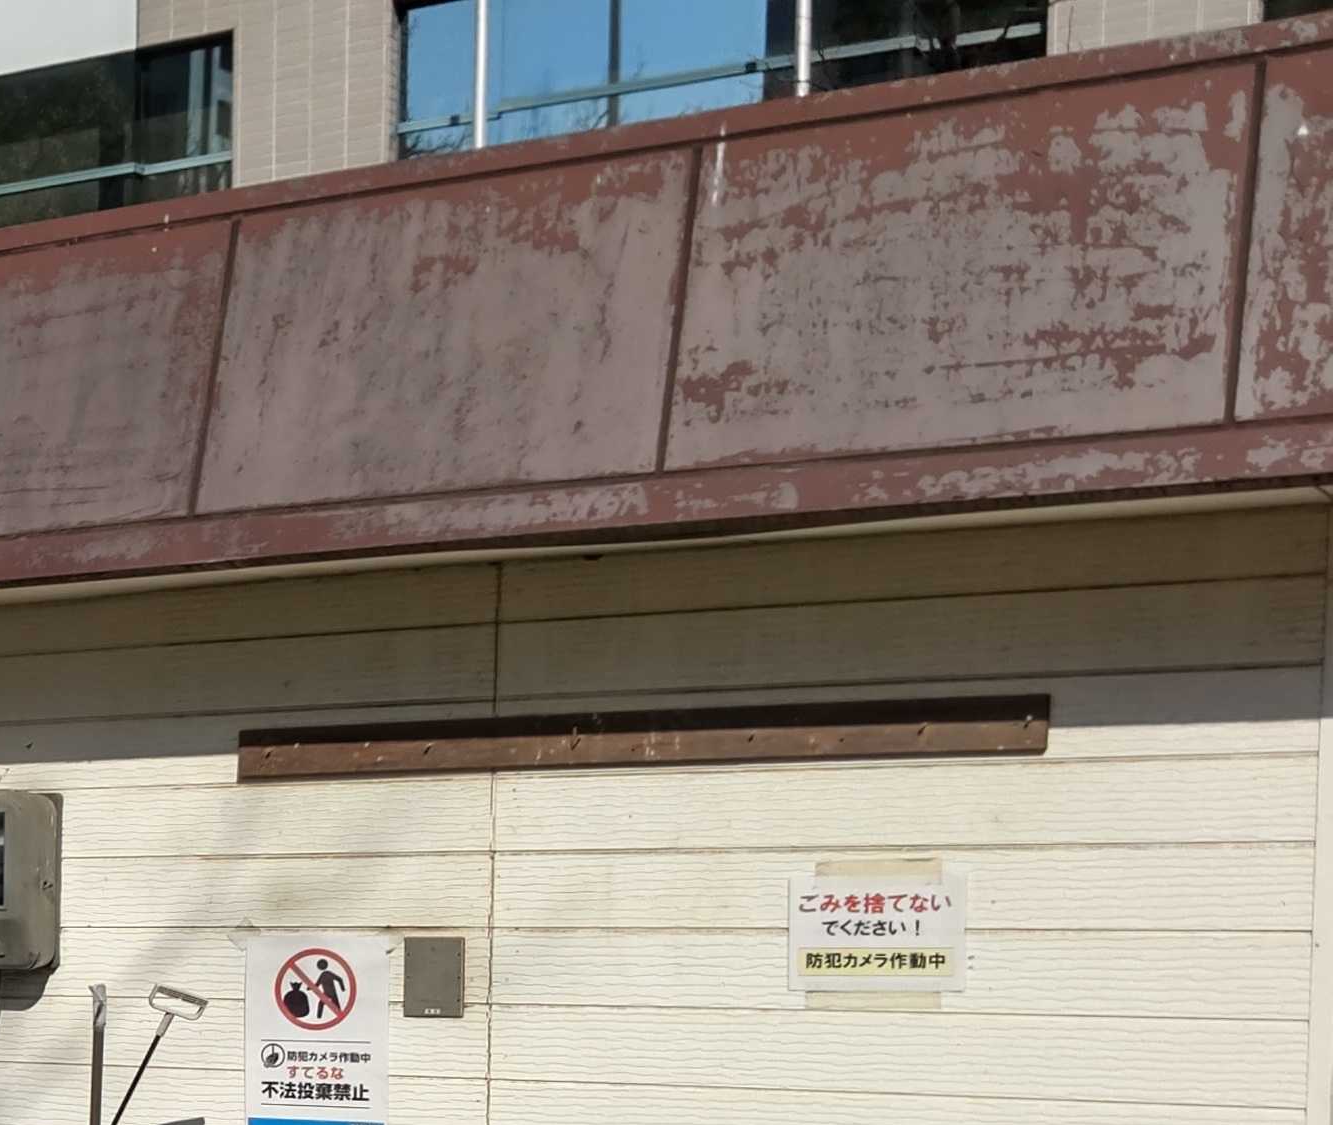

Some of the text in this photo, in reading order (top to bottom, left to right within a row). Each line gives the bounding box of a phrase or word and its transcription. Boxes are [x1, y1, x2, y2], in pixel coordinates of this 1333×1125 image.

[798, 893, 952, 914] ごみを捨てない
[805, 952, 946, 969] 防犯カメラ作動中
[287, 1050, 371, 1063] 防犯カメラ作動中
[287, 1065, 344, 1079] すてるな
[261, 1081, 370, 1102] 不法投棄禁止
